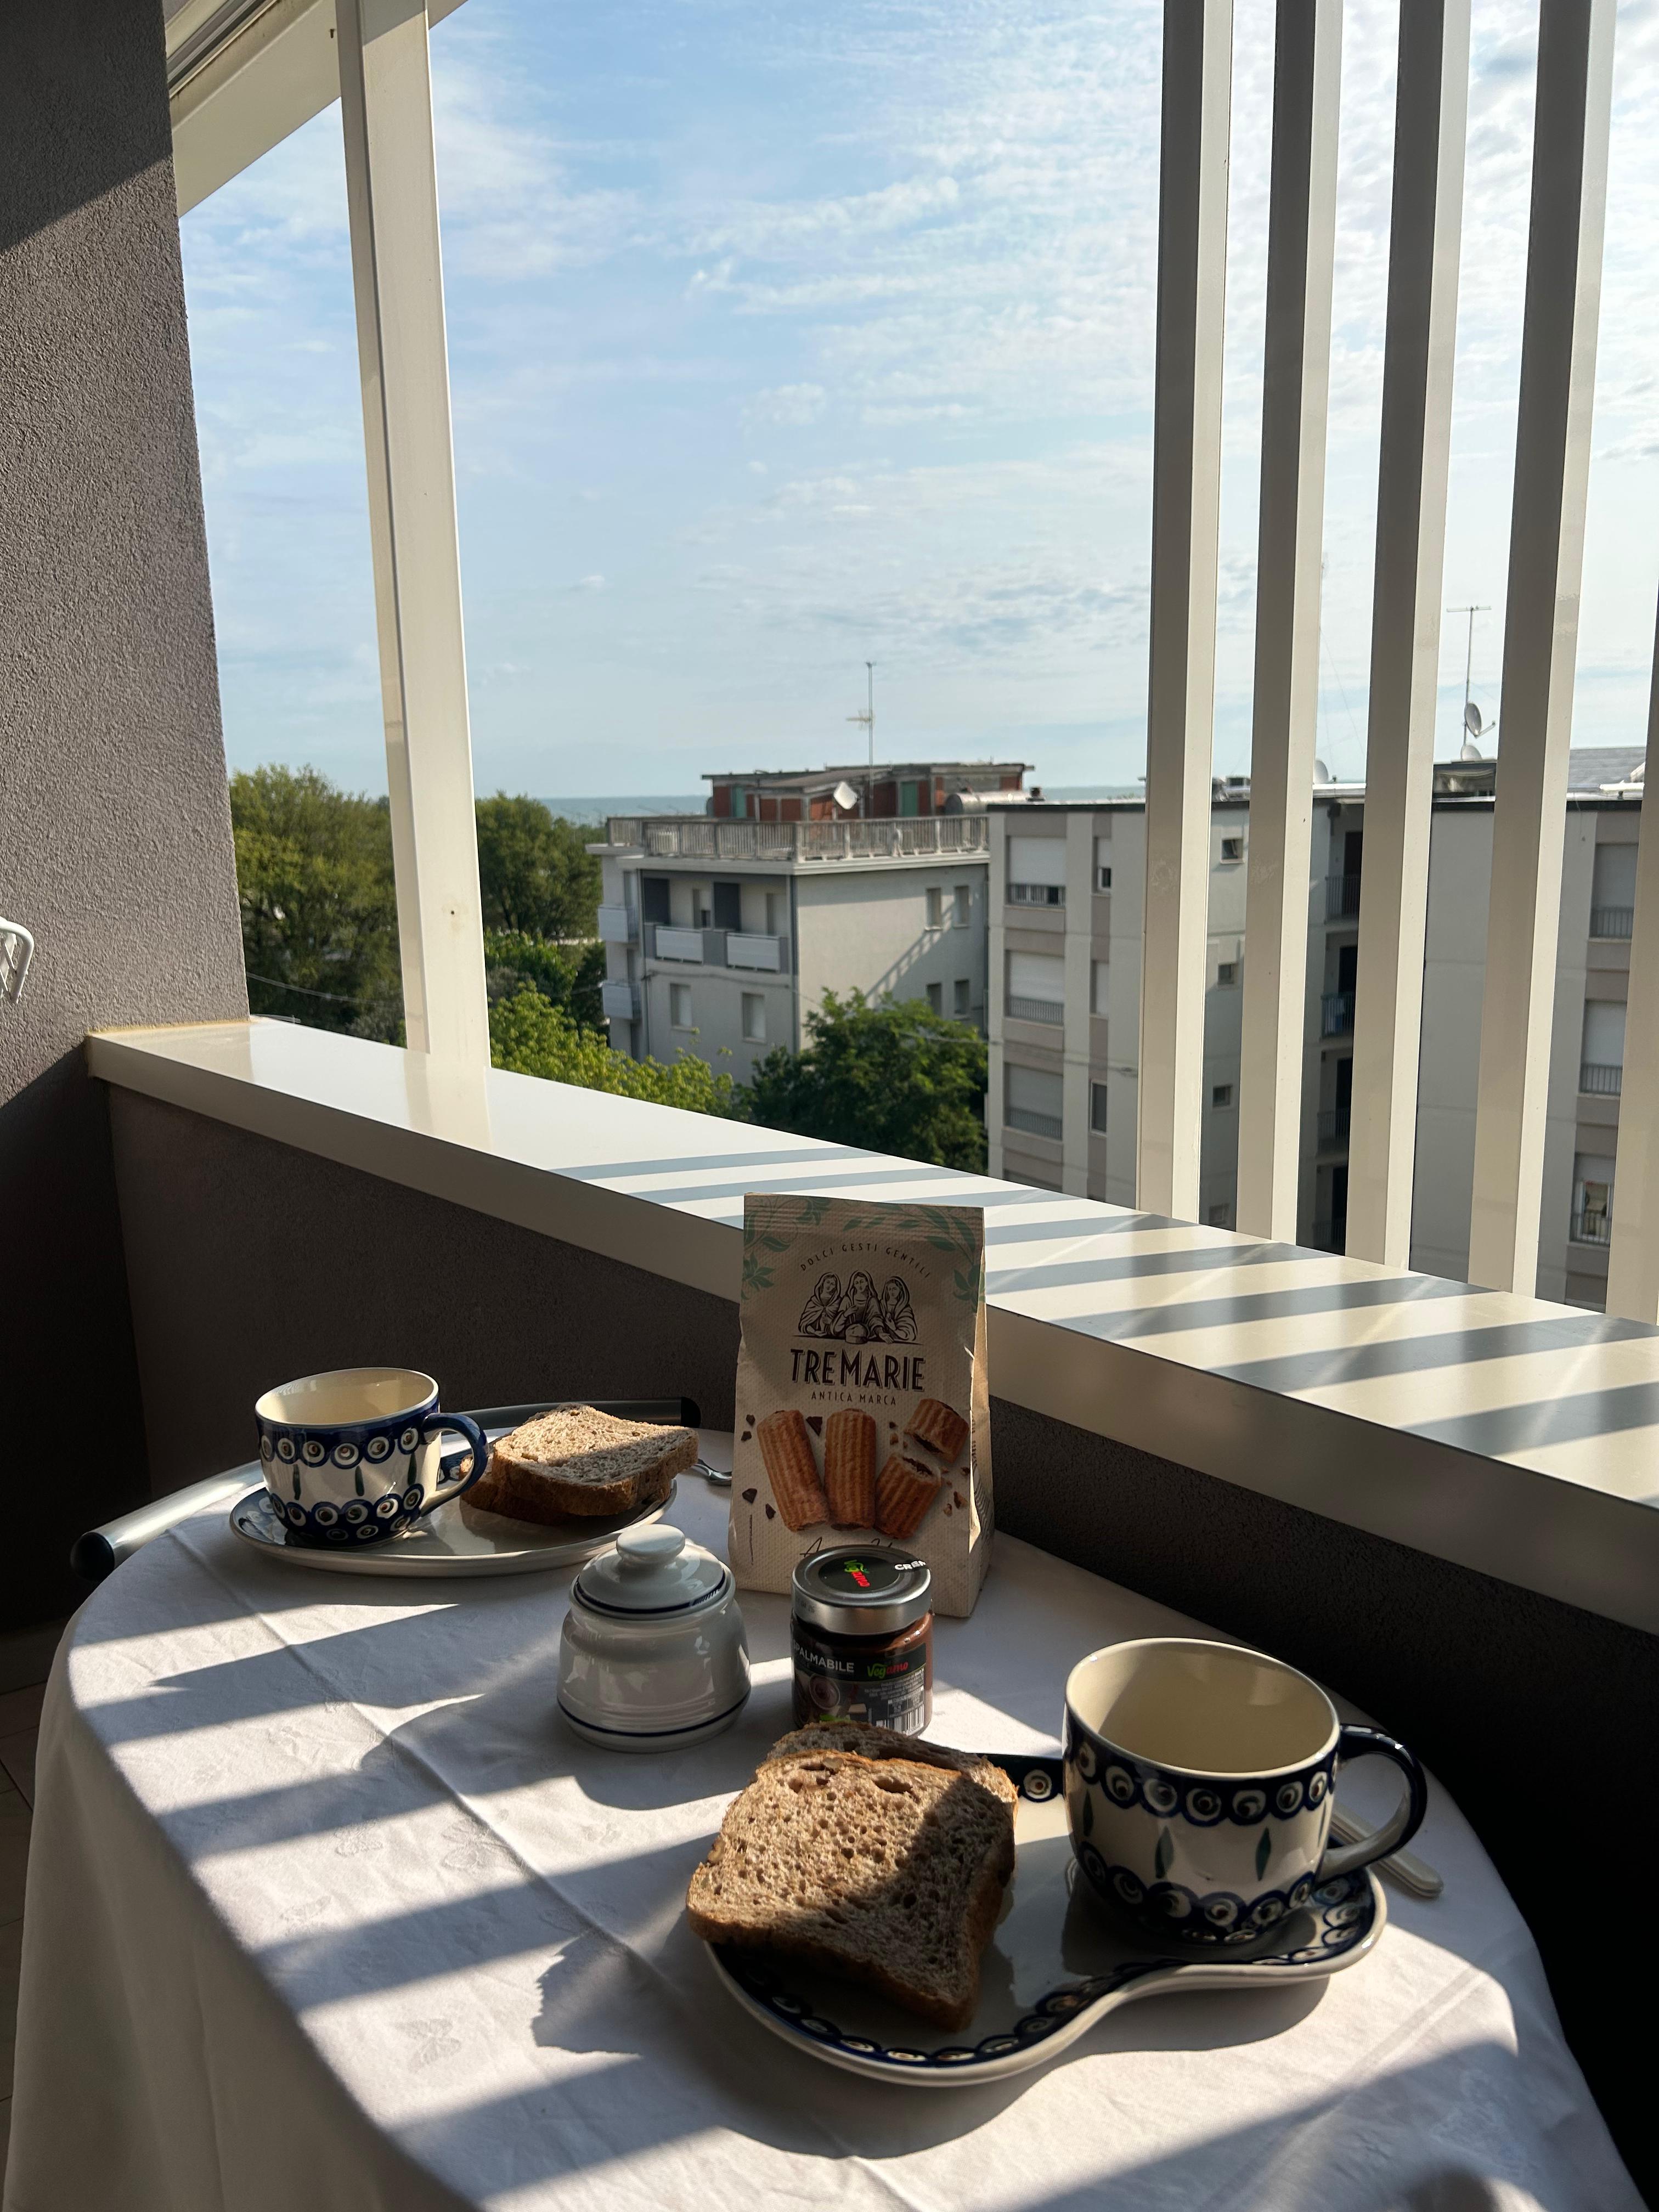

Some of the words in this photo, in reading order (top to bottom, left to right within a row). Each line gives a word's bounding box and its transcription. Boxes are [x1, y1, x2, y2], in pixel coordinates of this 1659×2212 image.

[800, 1248, 833, 1271] DOLCI
[842, 1243, 877, 1252] GESTI
[886, 1247, 931, 1278] GENTILI
[811, 1391, 853, 1403] ANTICA
[860, 1394, 896, 1406] MARCA
[867, 1661, 909, 1679] Vegamo
